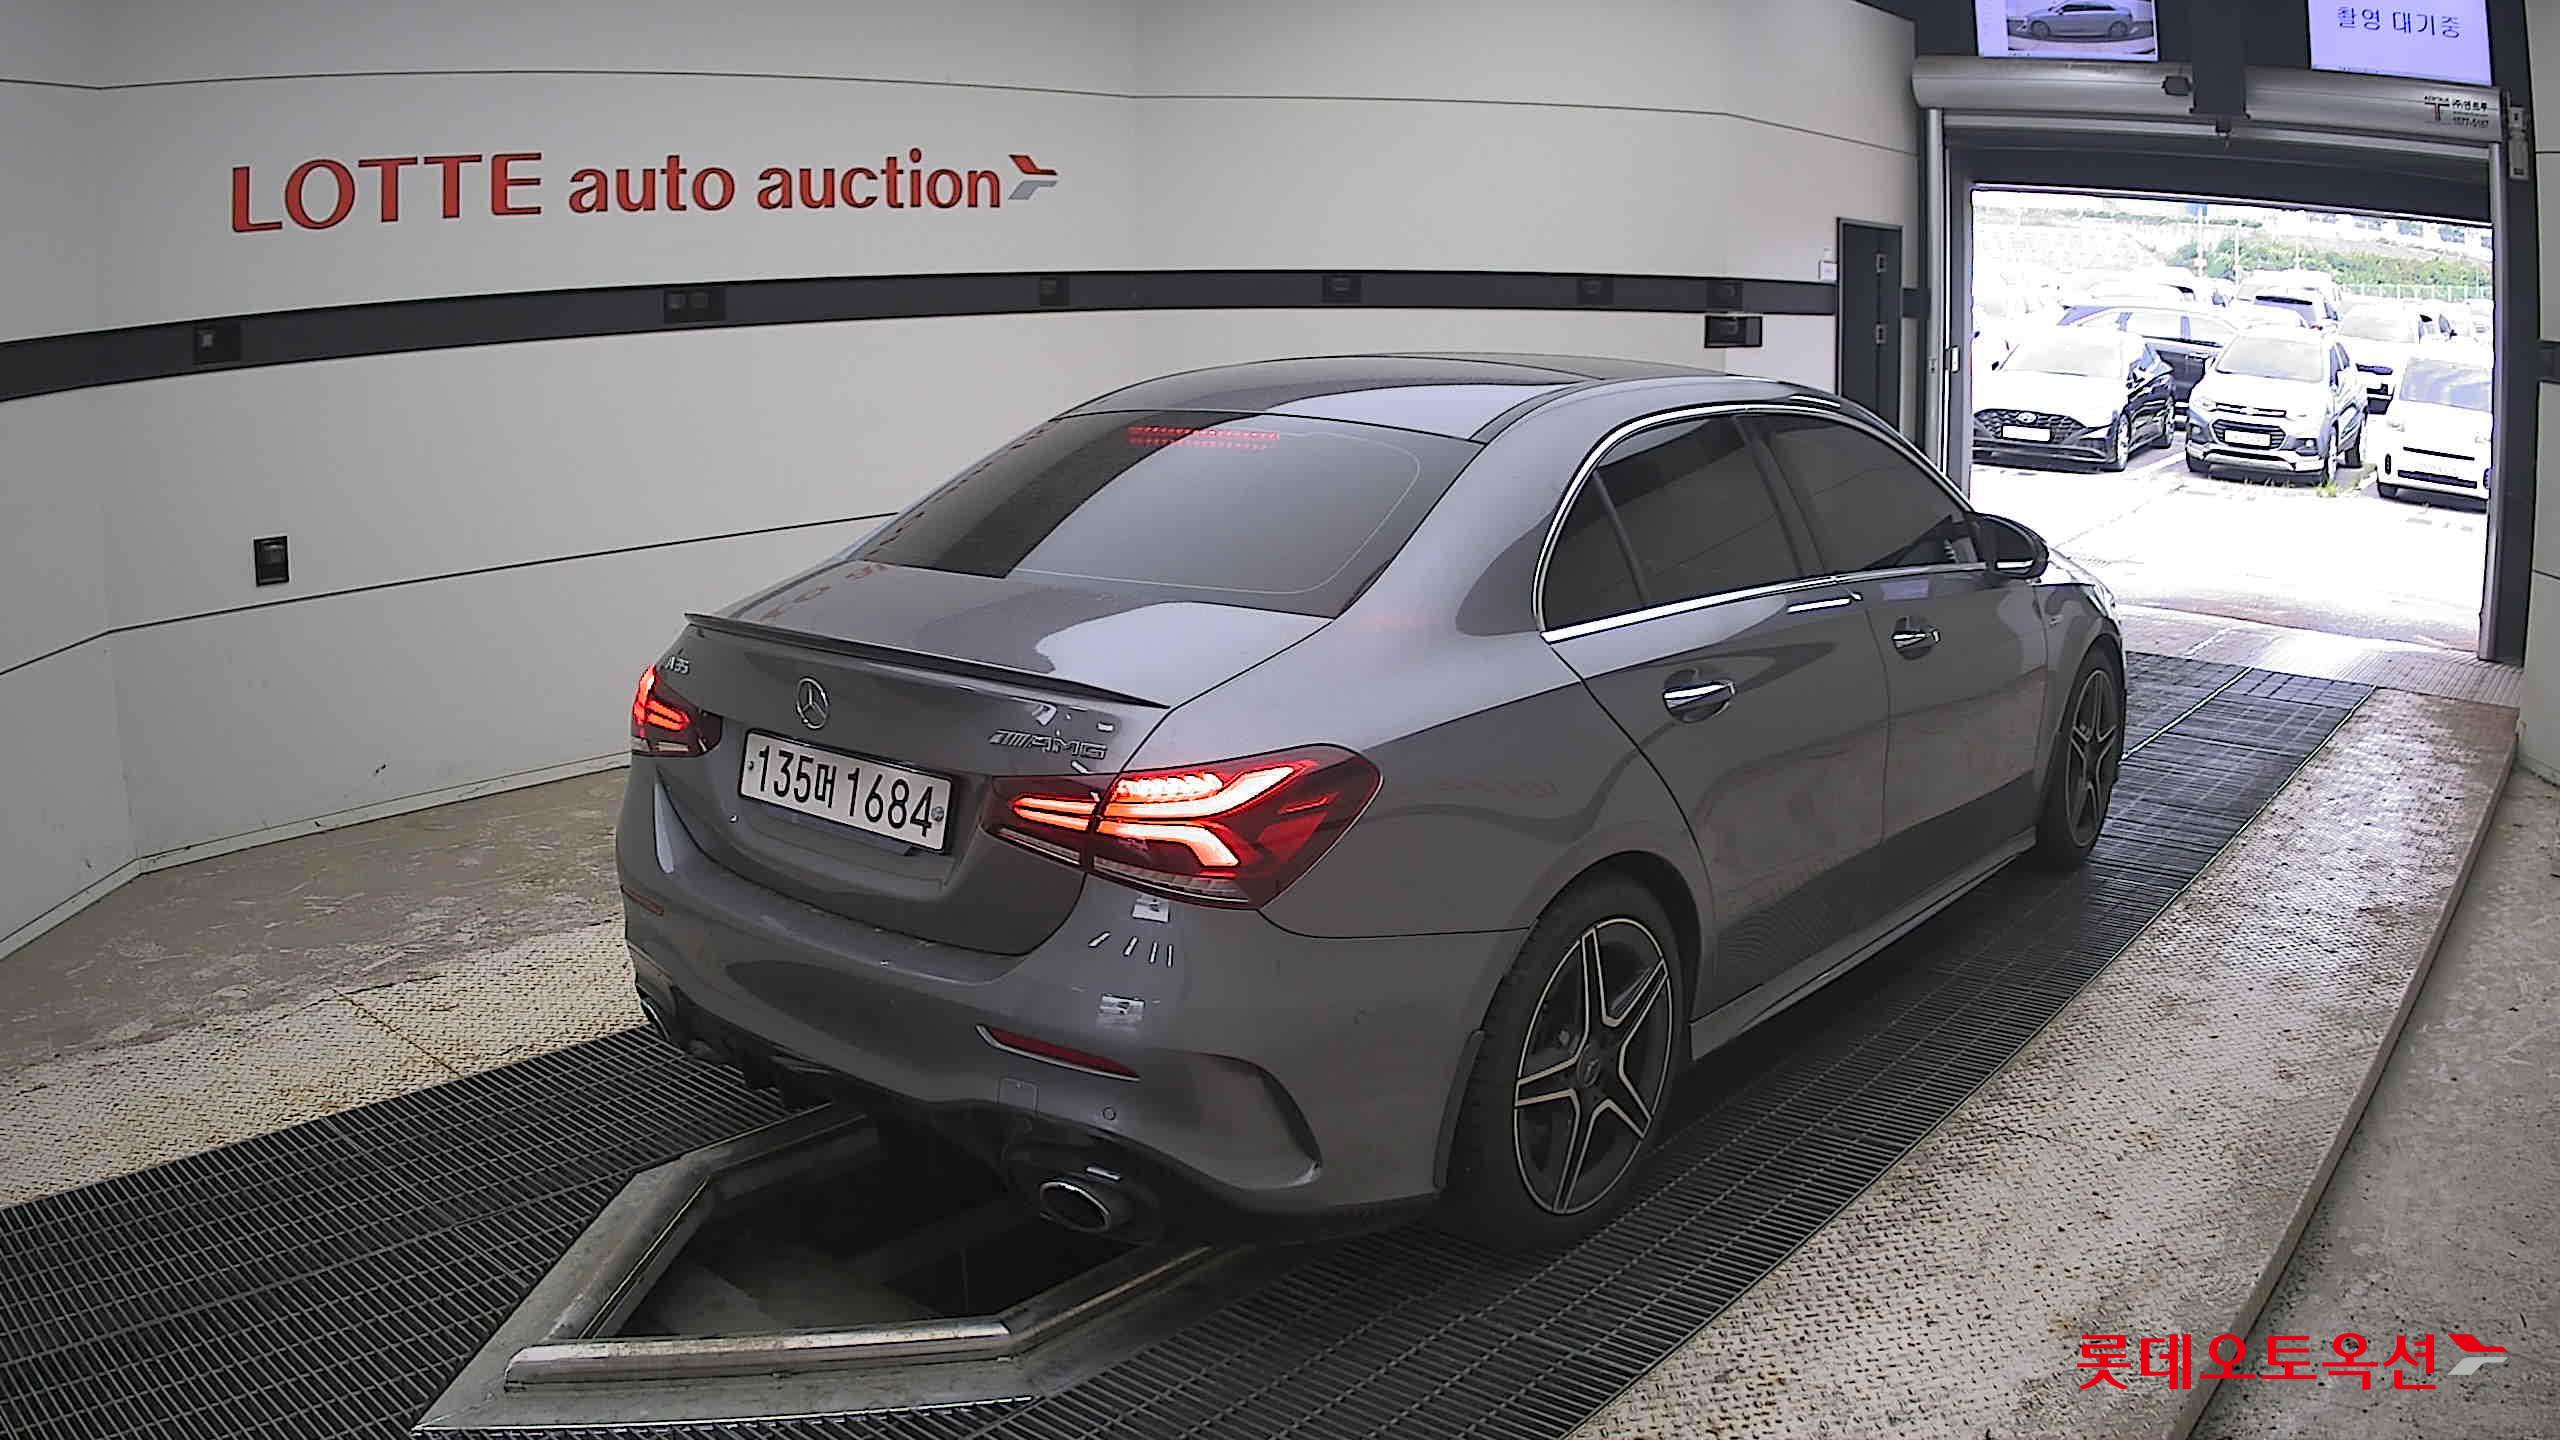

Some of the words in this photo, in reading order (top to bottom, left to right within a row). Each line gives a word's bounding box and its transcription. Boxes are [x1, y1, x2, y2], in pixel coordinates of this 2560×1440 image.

[2337, 6, 2380, 31] 촬영
[2392, 11, 2460, 39] 대기중
[231, 151, 543, 233] LOTTE
[568, 154, 735, 213] auto
[756, 148, 1002, 210] auction
[664, 655, 690, 675] A35
[758, 744, 838, 809] 135머
[846, 766, 934, 838] 1684
